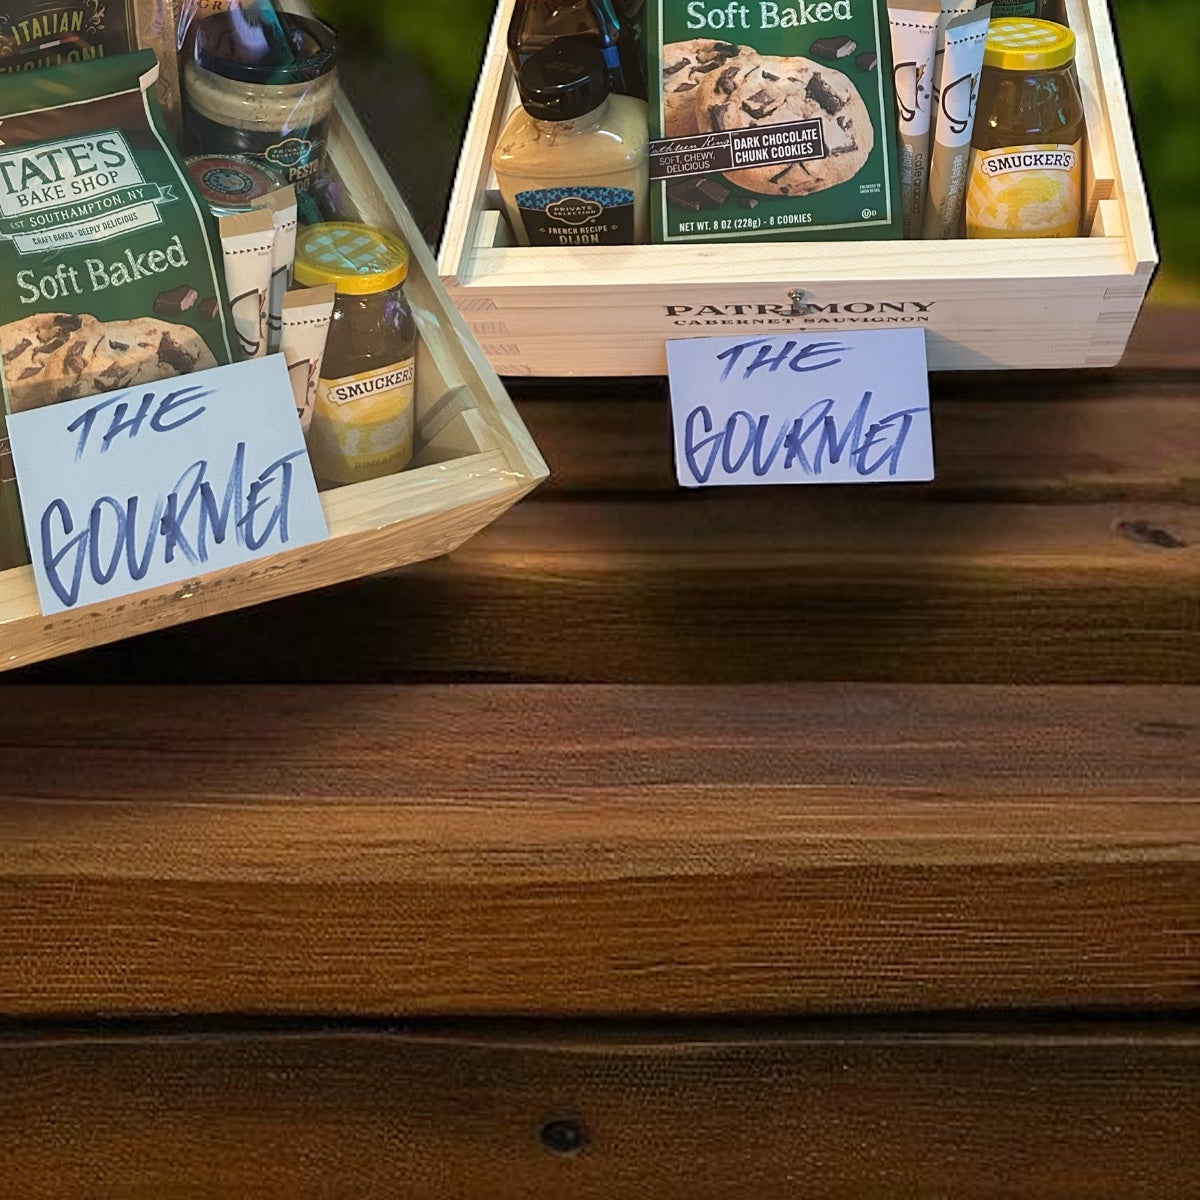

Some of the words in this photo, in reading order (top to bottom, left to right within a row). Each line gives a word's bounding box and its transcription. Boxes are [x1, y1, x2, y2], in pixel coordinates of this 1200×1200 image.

[686, 0, 751, 29] Soft
[10, 10, 84, 46] ITALIAN
[734, 136, 760, 151] DARK
[762, 128, 818, 147] CHOCOLATE
[659, 154, 683, 166] SOFT,
[684, 151, 716, 163] CHEWY,
[735, 147, 770, 164] CHUNK
[772, 142, 814, 158] COOKIES
[987, 152, 1072, 173] SMUCKER'S
[288, 158, 320, 182] PESTO
[666, 160, 711, 174] DELICIOUS
[15, 184, 66, 208] BAKE
[71, 170, 120, 195] SHOP
[29, 195, 126, 228] SOUTHAMPTON,
[127, 188, 145, 201] NY
[32, 235, 52, 246] CRAFT
[52, 232, 74, 243] BAKED
[77, 224, 102, 238] DEEPLY
[101, 211, 139, 232] DELICIOUS
[548, 227, 578, 235] FRENCH
[580, 225, 608, 234] RECIPE
[679, 222, 695, 233] NET
[696, 221, 711, 232] WT.
[713, 220, 719, 230] 8
[721, 219, 733, 230] OZ
[734, 218, 761, 230] (228g)
[769, 216, 775, 226] 8
[777, 213, 812, 226] COOKIES
[559, 233, 600, 245] DIJON
[15, 263, 83, 305] Soft
[84, 234, 190, 292] Baked
[663, 301, 938, 317] PATRMONY
[673, 318, 795, 326] CABERNET
[803, 316, 930, 324] SAUVIGNON
[716, 337, 856, 383] THE
[334, 367, 414, 402] SMUCKER'S
[67, 385, 221, 464] THE
[685, 391, 930, 484] GOURMET
[40, 442, 309, 608] GOURMET
